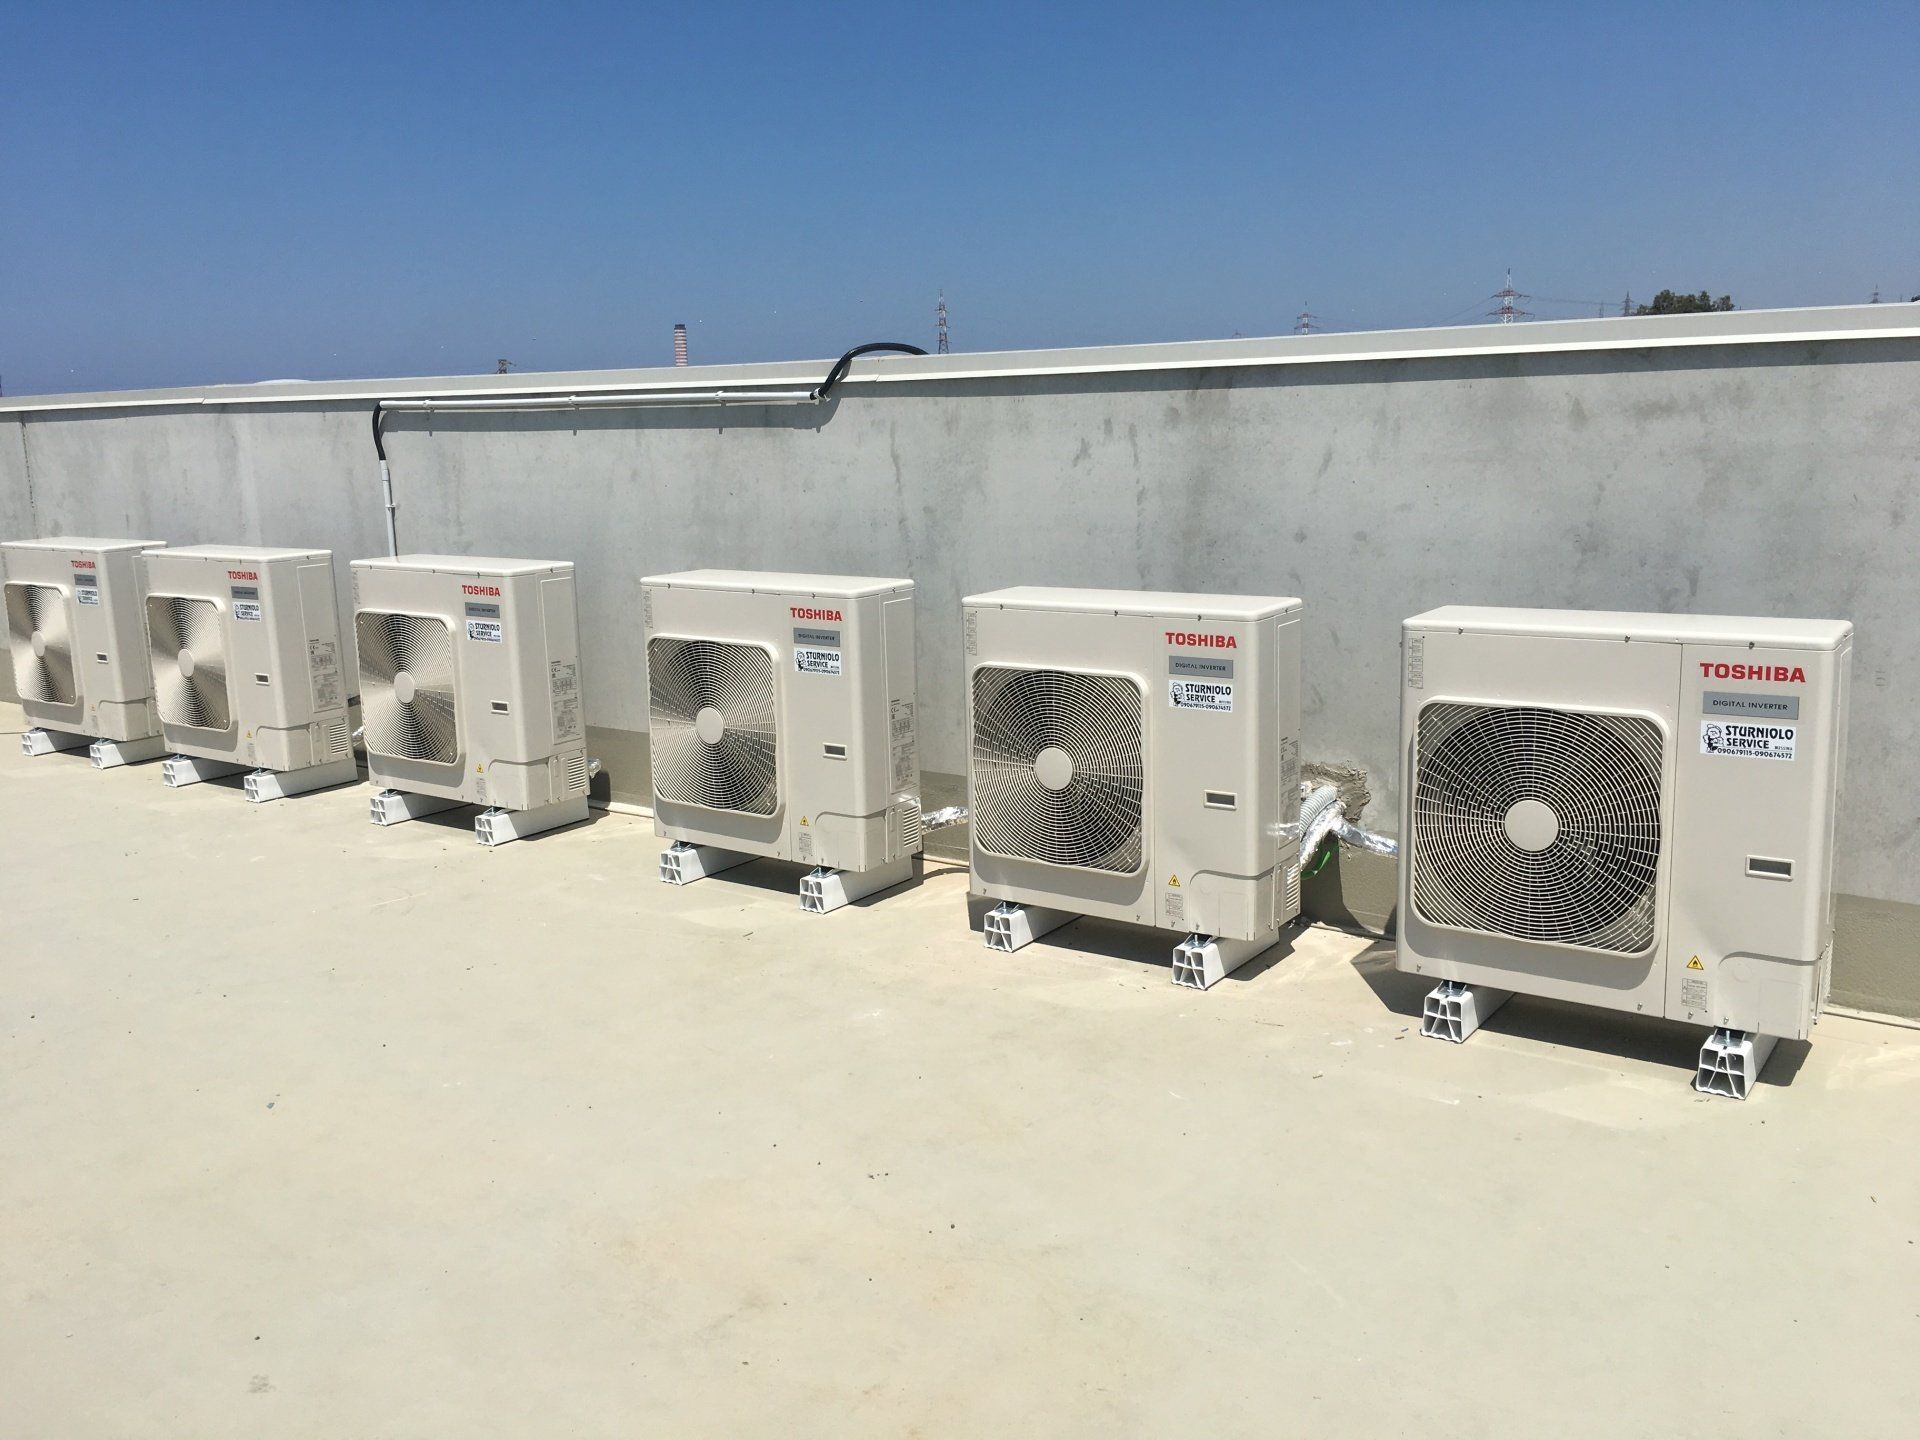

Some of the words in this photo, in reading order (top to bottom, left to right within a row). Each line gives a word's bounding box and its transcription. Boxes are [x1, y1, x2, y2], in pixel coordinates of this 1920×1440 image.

[227, 571, 258, 580] TOSHIBA
[462, 585, 500, 596] TOSHIBA
[790, 608, 842, 621] TOSHIBA
[1165, 632, 1237, 648] TOSHIBA
[806, 652, 839, 661] STURNIOLO
[807, 660, 828, 668] SERVICE
[1699, 663, 1806, 682] TOSHIBA
[1185, 684, 1232, 695] STURNIOLO
[1186, 694, 1216, 703] SERVICE
[1713, 700, 1746, 708] DIGITAL
[1748, 702, 1788, 710] INVERTER
[1725, 725, 1794, 740] STURNIOLO
[1726, 738, 1770, 749] SERVICE
[1717, 747, 1793, 759] 090679115-090674572
